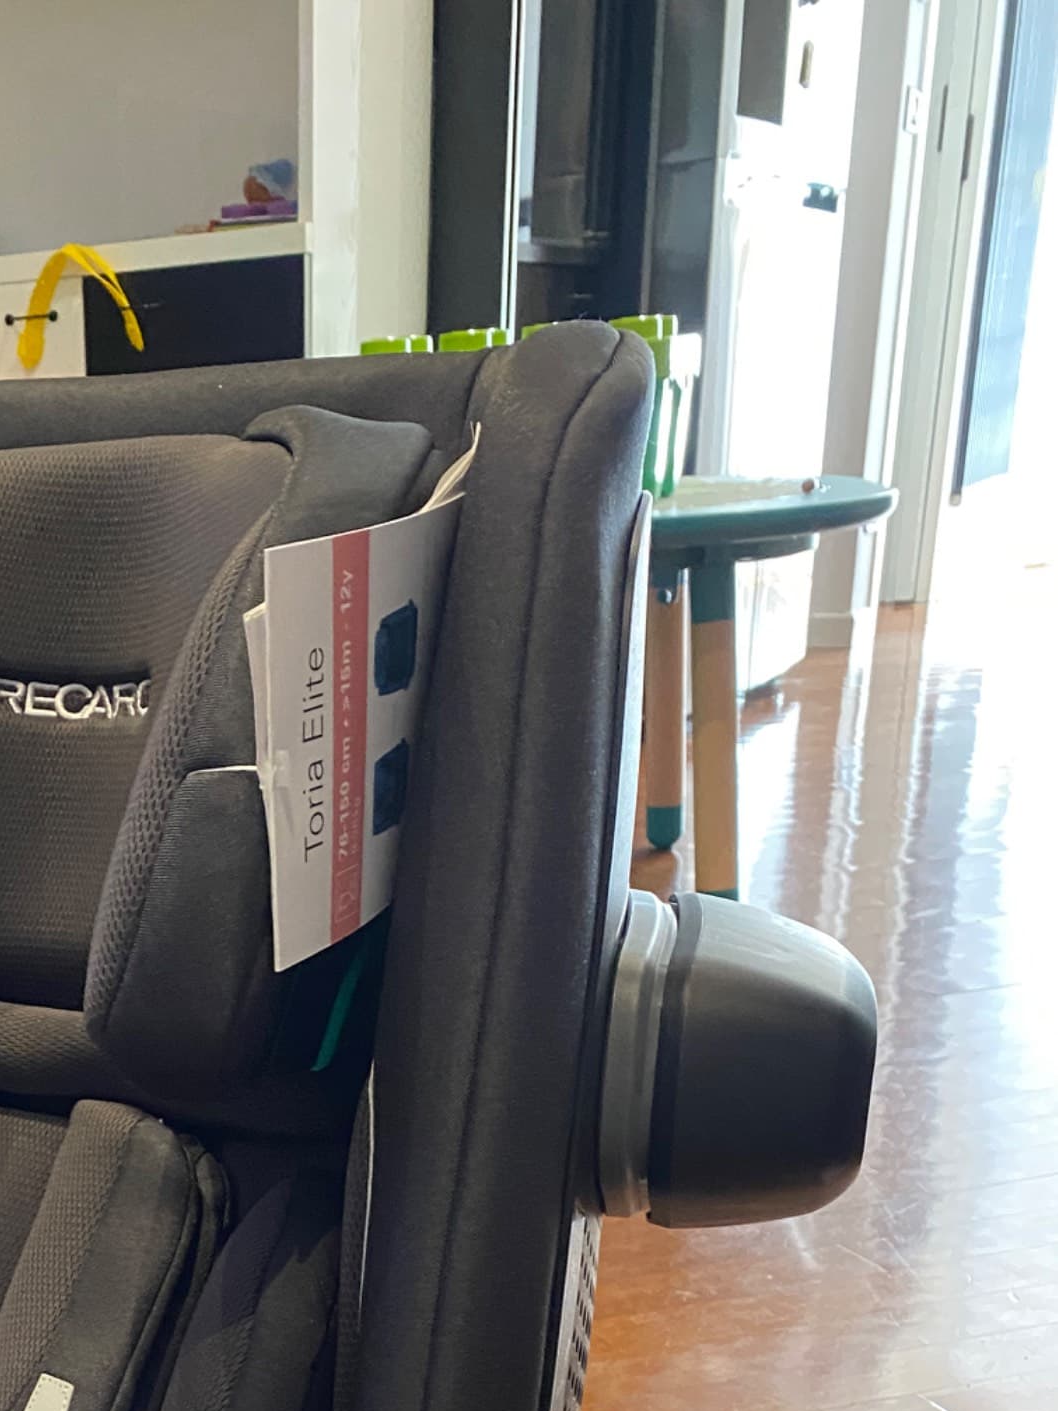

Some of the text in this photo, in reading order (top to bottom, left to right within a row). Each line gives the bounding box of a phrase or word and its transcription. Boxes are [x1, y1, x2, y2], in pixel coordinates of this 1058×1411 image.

[302, 646, 325, 864] Toria Elite
[341, 736, 352, 775] cm
